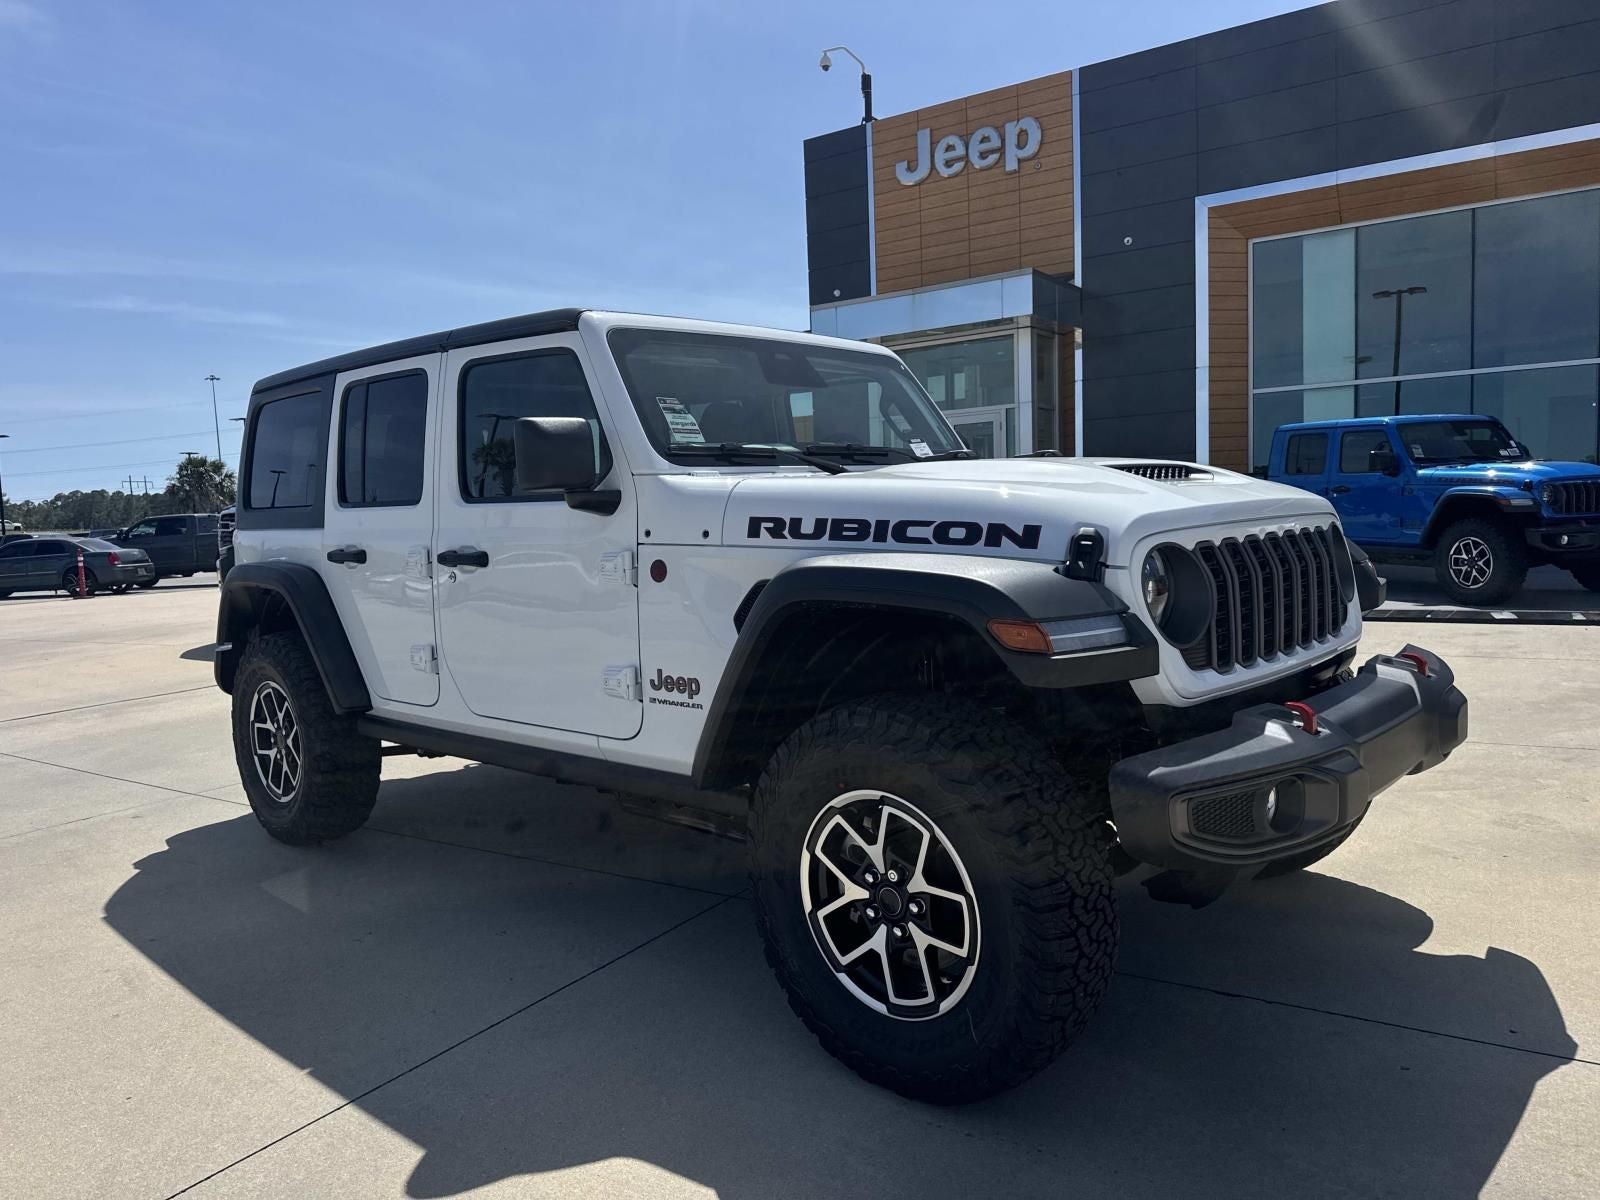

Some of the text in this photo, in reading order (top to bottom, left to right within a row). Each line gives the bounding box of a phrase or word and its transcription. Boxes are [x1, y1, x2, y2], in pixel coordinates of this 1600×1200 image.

[895, 116, 1042, 186] Jeep
[747, 516, 1042, 550] RUBICON
[649, 668, 701, 700] Jeep
[656, 697, 704, 710] WRANGLER
